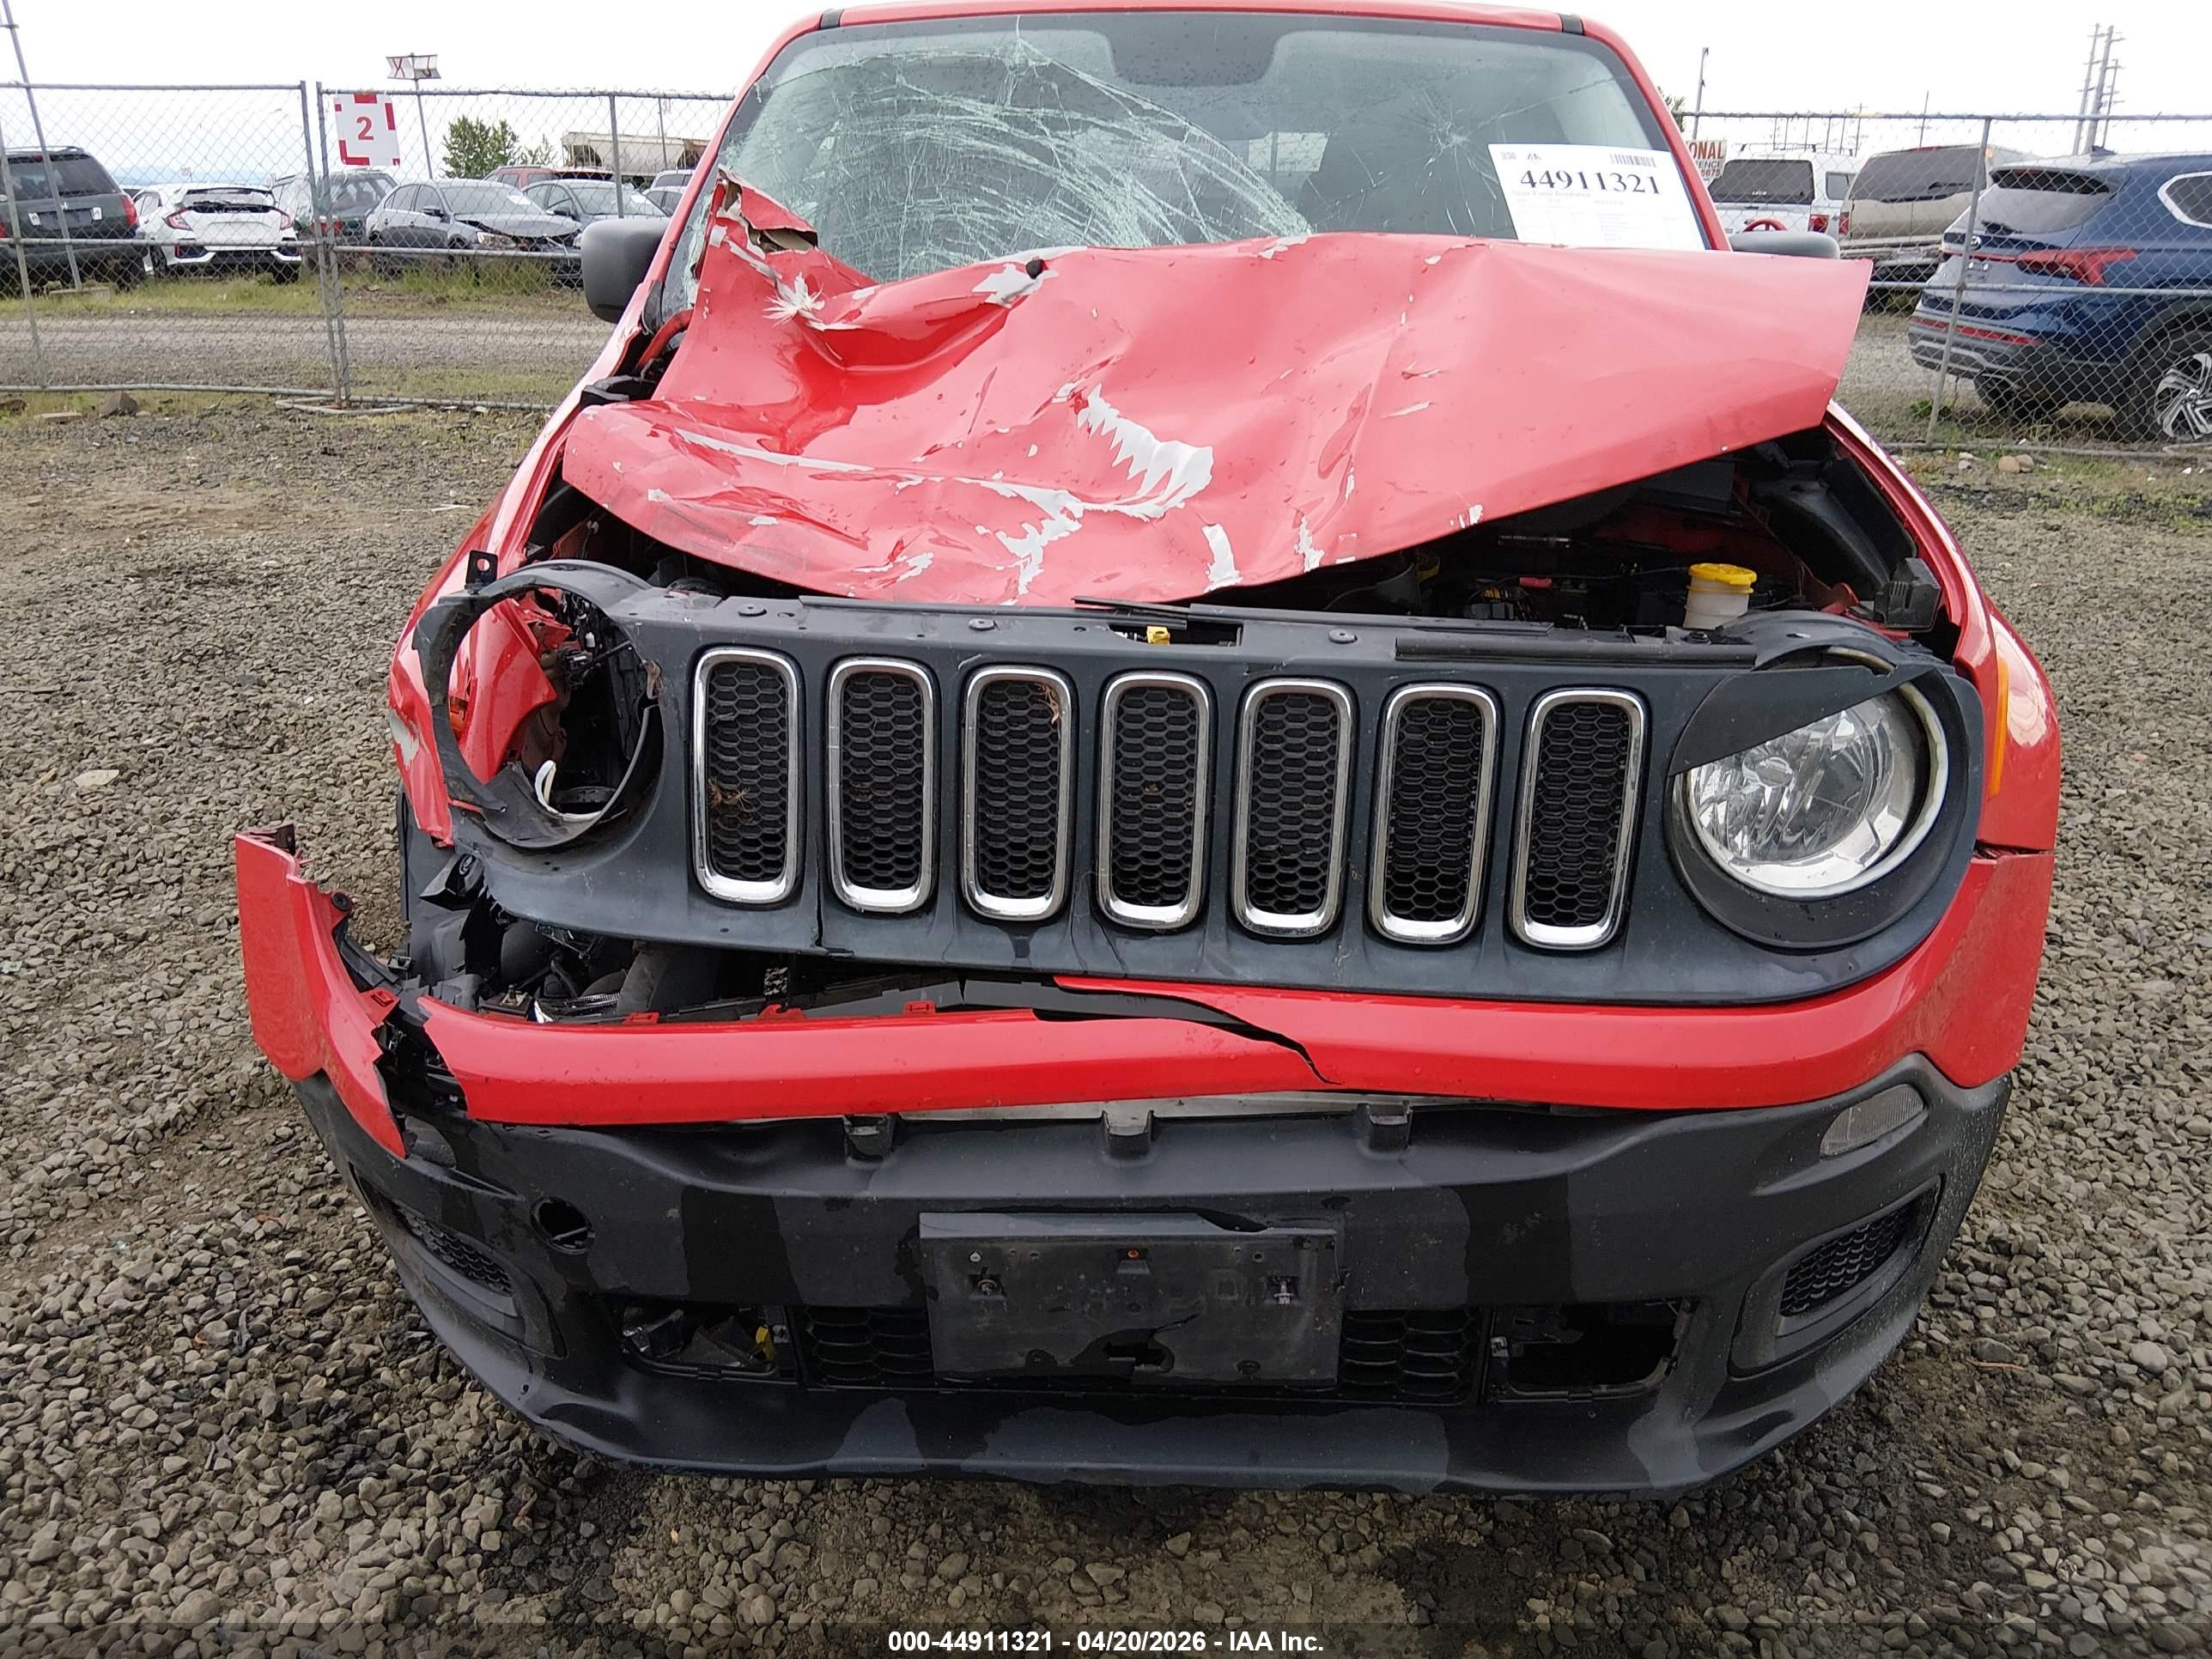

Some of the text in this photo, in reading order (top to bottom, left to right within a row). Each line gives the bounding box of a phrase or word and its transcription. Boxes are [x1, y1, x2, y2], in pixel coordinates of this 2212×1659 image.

[356, 116, 374, 141] 2
[1686, 141, 1724, 160] ONAL
[1520, 169, 1661, 195] 44911321
